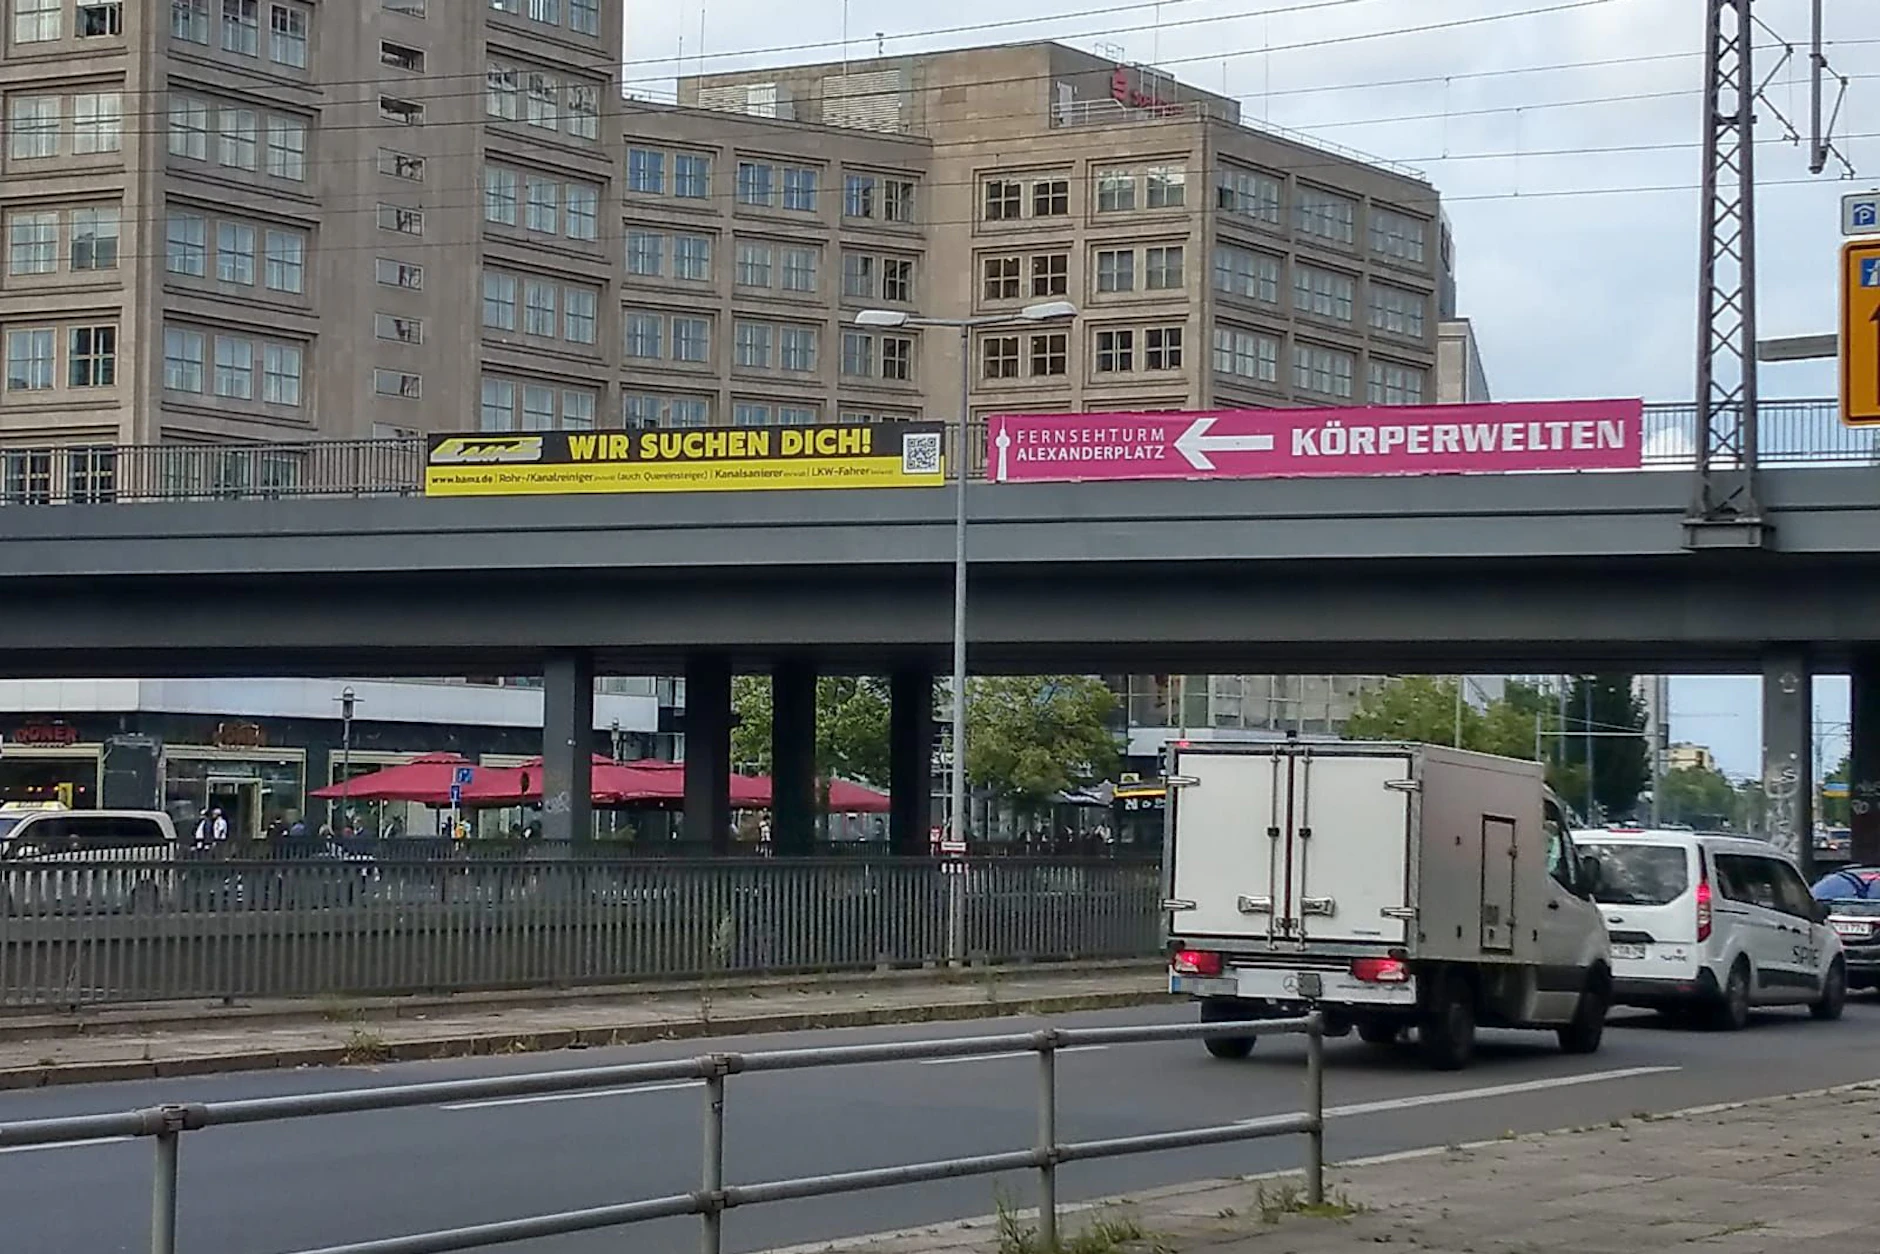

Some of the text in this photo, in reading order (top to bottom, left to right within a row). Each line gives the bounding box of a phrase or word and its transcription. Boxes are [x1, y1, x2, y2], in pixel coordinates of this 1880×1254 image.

[567, 428, 872, 460] WIR SUCHEN DICH!
[1016, 428, 1165, 444] FERNSEHTURM
[1291, 419, 1627, 457] KÖRPERWELTEN
[1016, 445, 1165, 461] ALEXANDERPLATZ
[715, 468, 783, 478] Kanalsanierer
[811, 466, 869, 476] LKW-Fahrer
